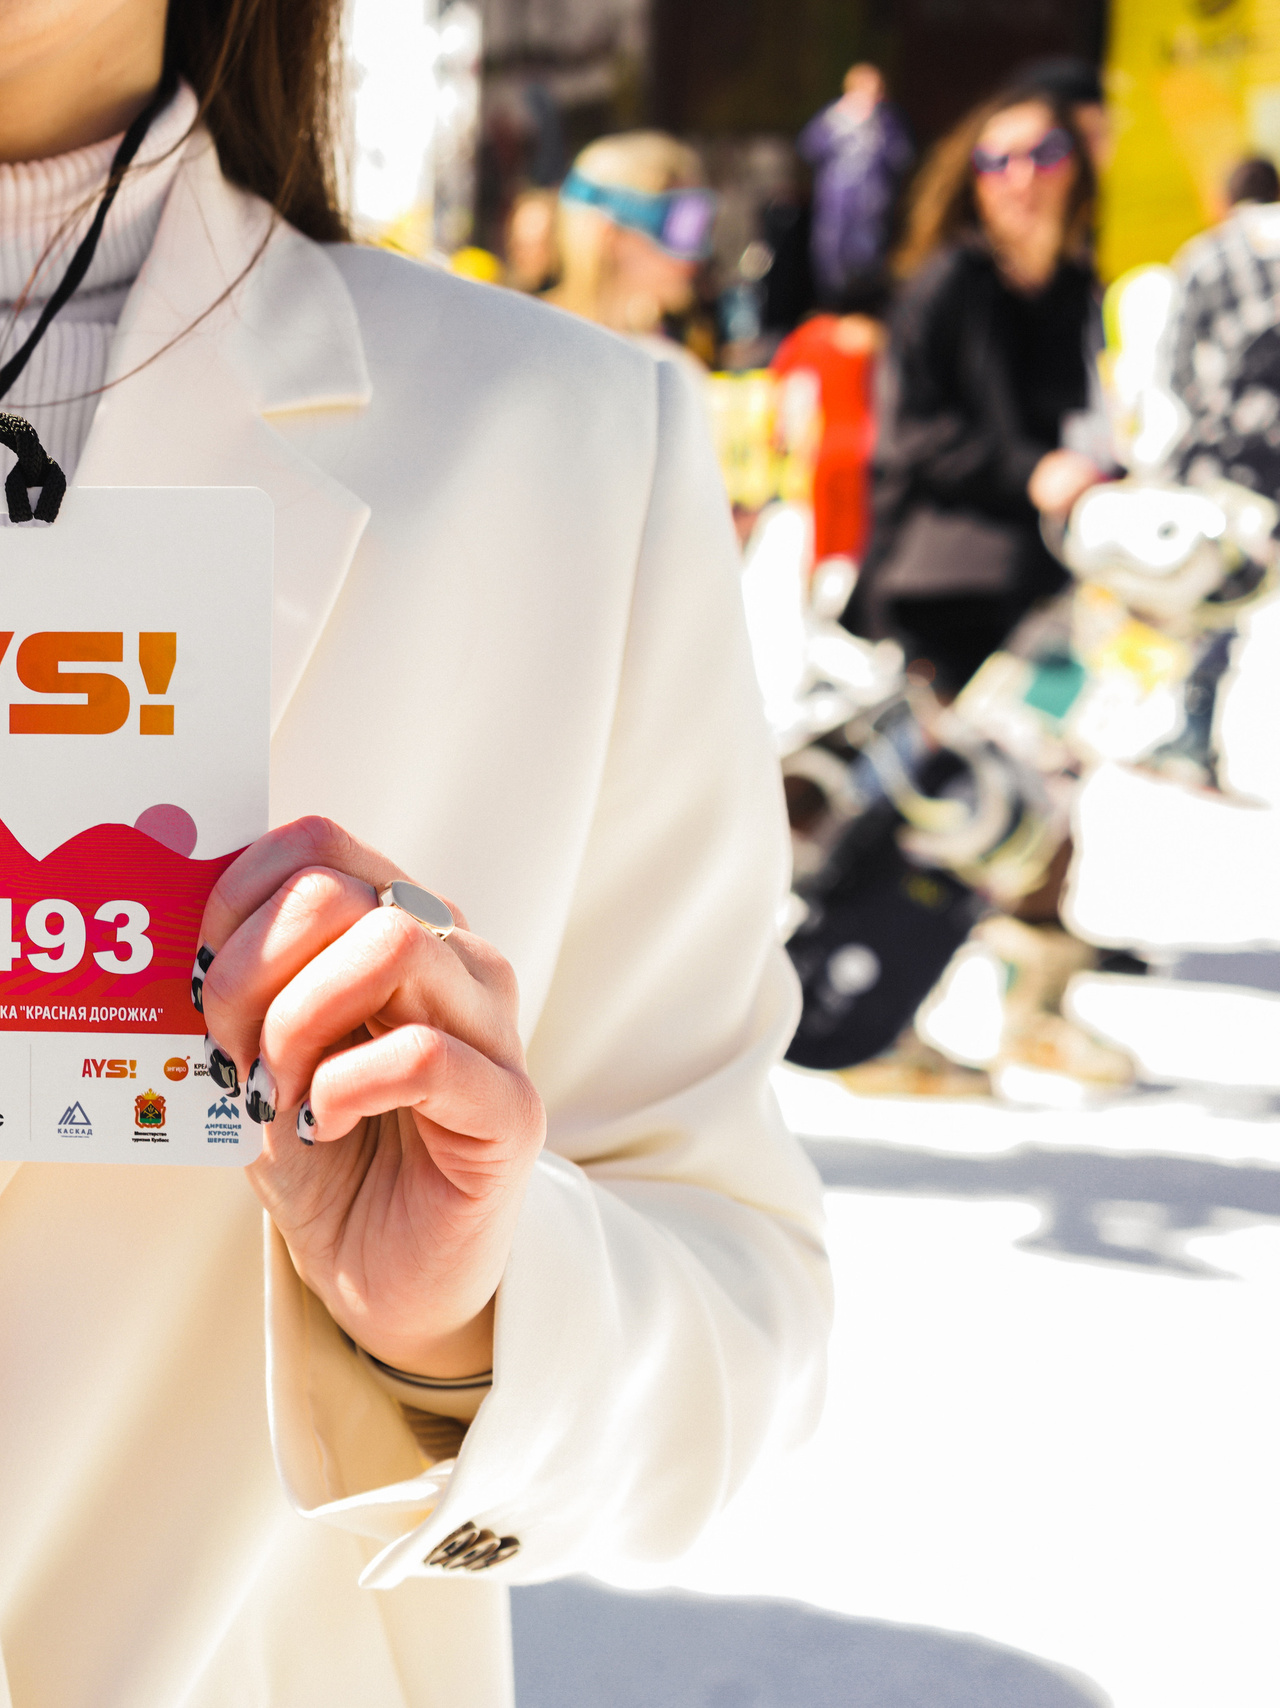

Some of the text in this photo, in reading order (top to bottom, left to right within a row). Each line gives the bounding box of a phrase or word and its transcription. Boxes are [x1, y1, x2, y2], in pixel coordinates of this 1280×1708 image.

[20, 1005, 87, 1021] "КРАСНАЯ
[89, 1006, 164, 1022] ДОРОЖКА"
[82, 1058, 137, 1079] AYS!
[57, 1128, 93, 1136] КАСКАД
